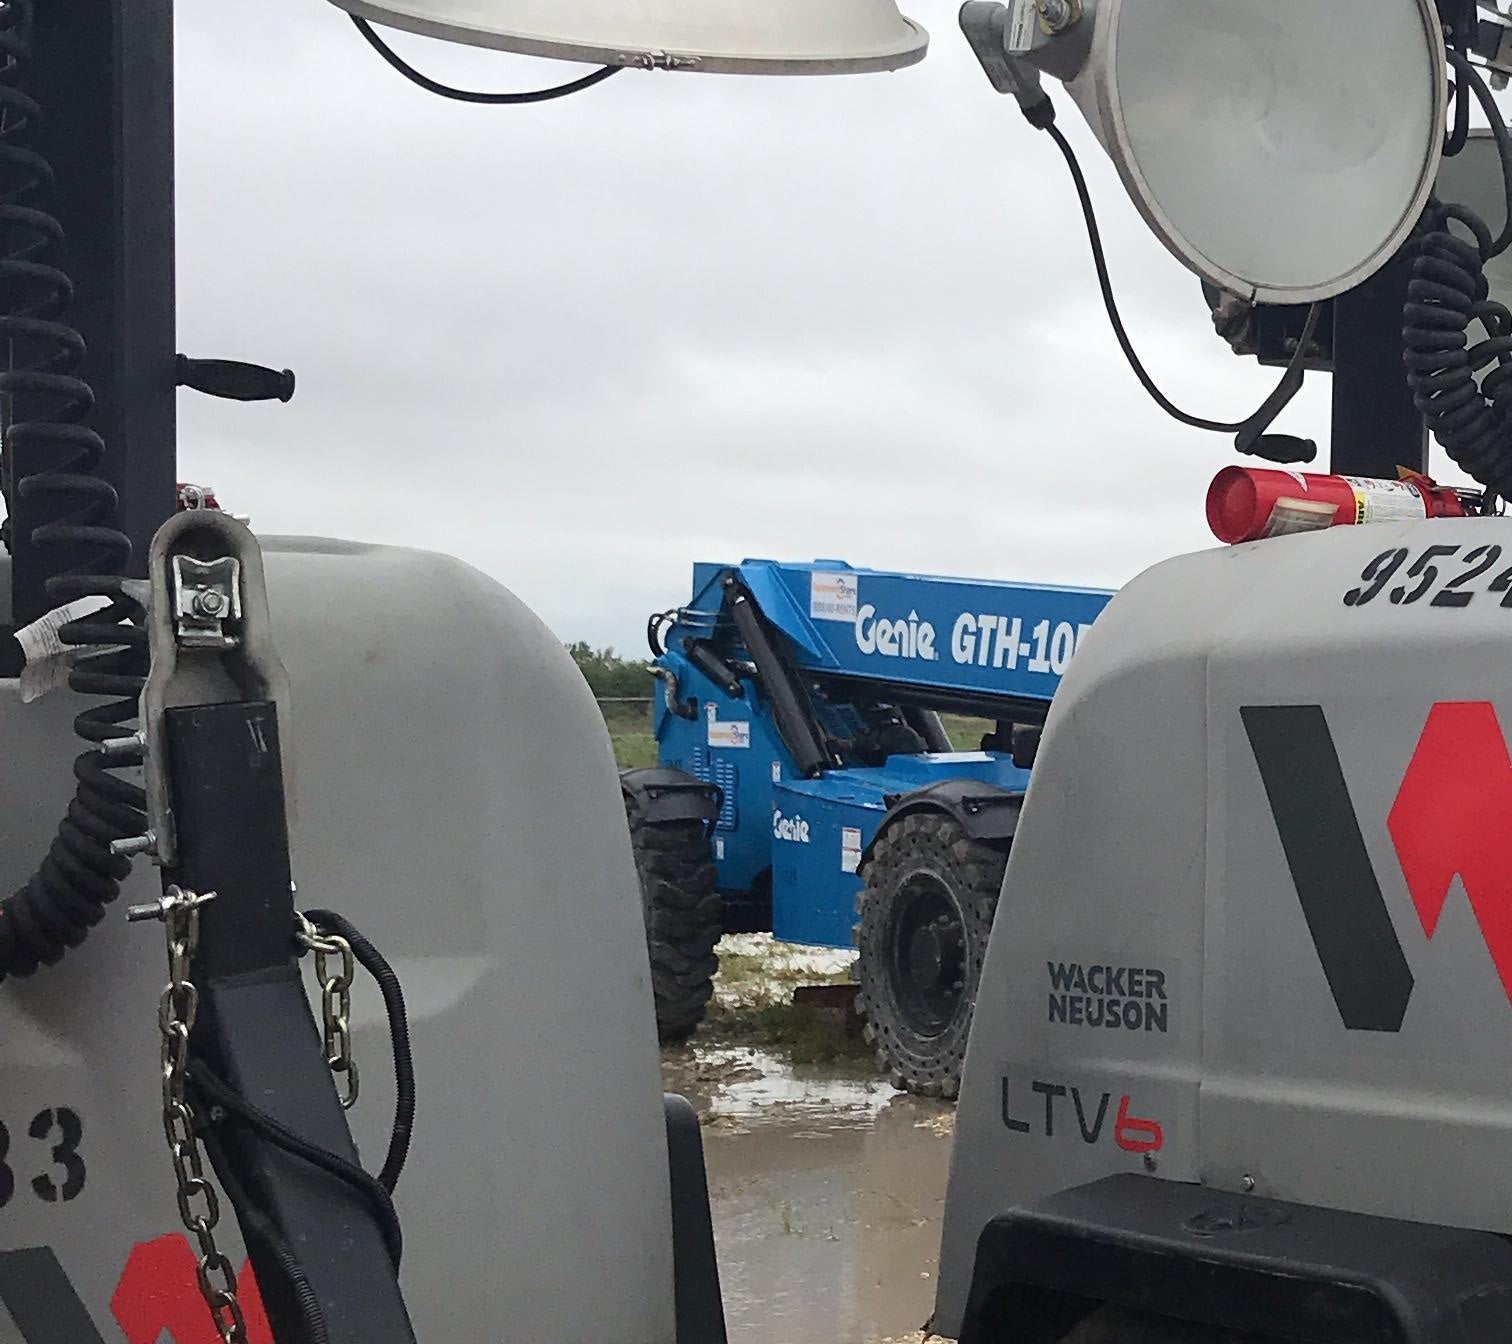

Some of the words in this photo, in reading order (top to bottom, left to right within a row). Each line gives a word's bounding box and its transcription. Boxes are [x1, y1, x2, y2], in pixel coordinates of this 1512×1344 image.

[855, 604, 936, 660] Genie
[772, 809, 810, 843] Genie
[1047, 961, 1168, 1000] WACKER
[1048, 993, 1168, 1033] NEUSON
[1002, 1076, 1164, 1153] LTV6
[0, 1107, 87, 1205] 3
